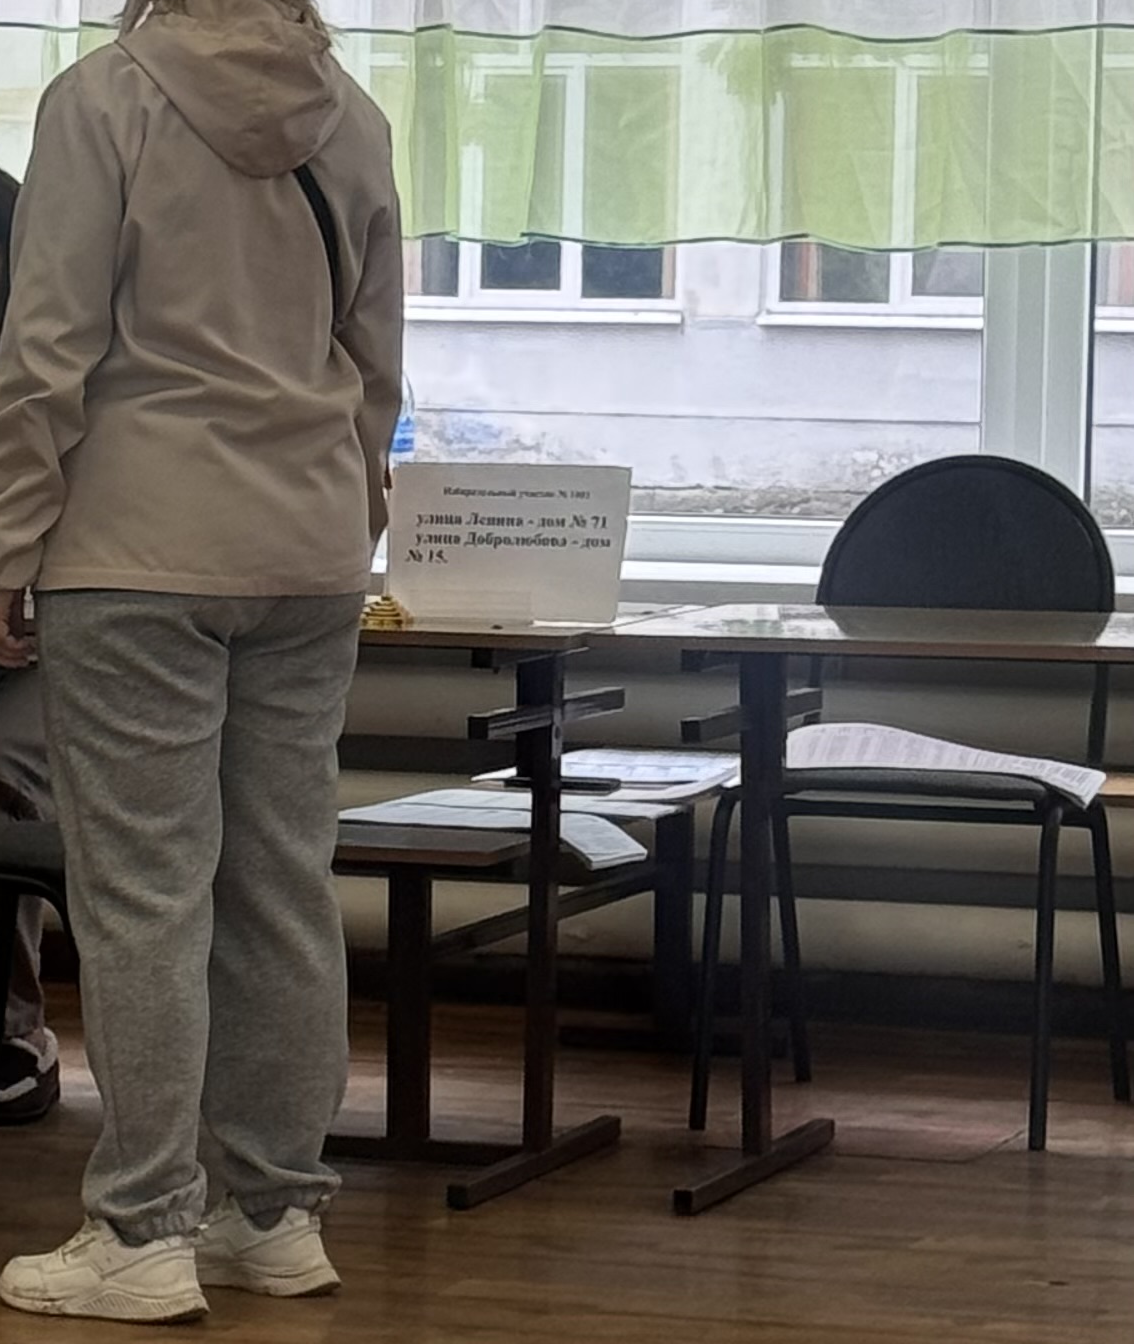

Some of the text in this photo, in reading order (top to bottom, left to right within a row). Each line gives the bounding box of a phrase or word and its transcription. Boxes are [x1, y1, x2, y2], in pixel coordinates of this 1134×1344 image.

[416, 513, 462, 527] улица
[465, 512, 523, 527] Ленина
[537, 517, 566, 528] дом
[568, 514, 587, 529] №
[591, 516, 607, 529] 71
[415, 533, 461, 546] улица
[464, 531, 567, 549] Добролюбова
[580, 537, 611, 549] дом
[405, 549, 423, 563] №
